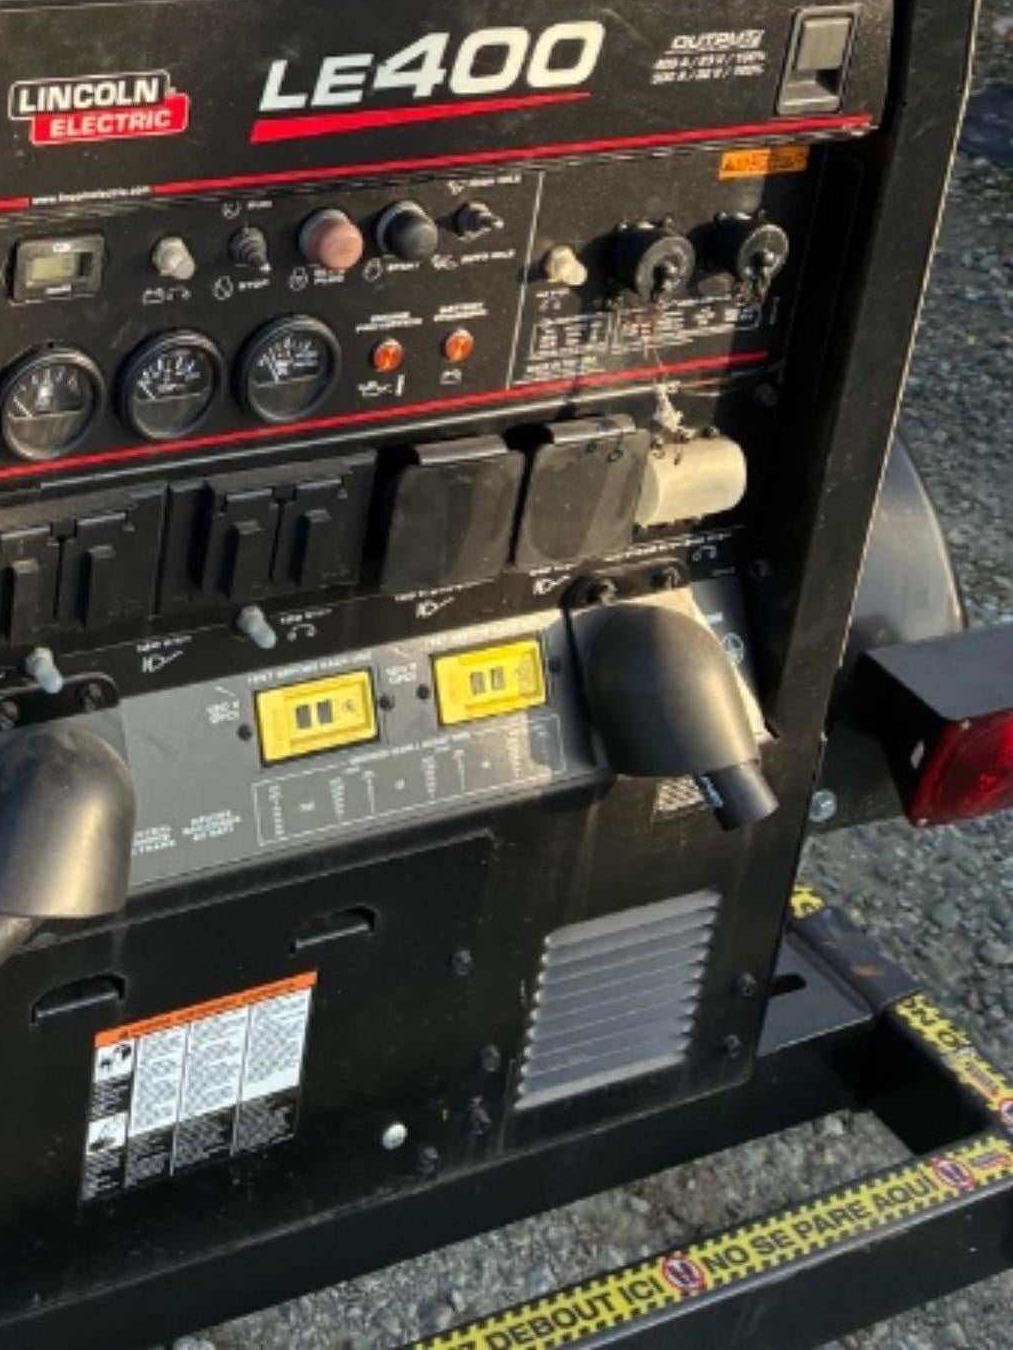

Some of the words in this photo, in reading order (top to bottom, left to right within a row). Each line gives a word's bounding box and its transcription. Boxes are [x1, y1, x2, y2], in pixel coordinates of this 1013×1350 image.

[260, 19, 606, 112] LE400
[670, 29, 765, 50] OUTPUT
[18, 77, 161, 114] LINCOLN
[49, 108, 173, 139] ELECTRIC
[705, 1244, 751, 1276] NO
[754, 1228, 792, 1256] SE
[796, 1203, 870, 1243] PARE
[485, 1290, 618, 1350] DEBOUT
[619, 1274, 666, 1306] ICI
